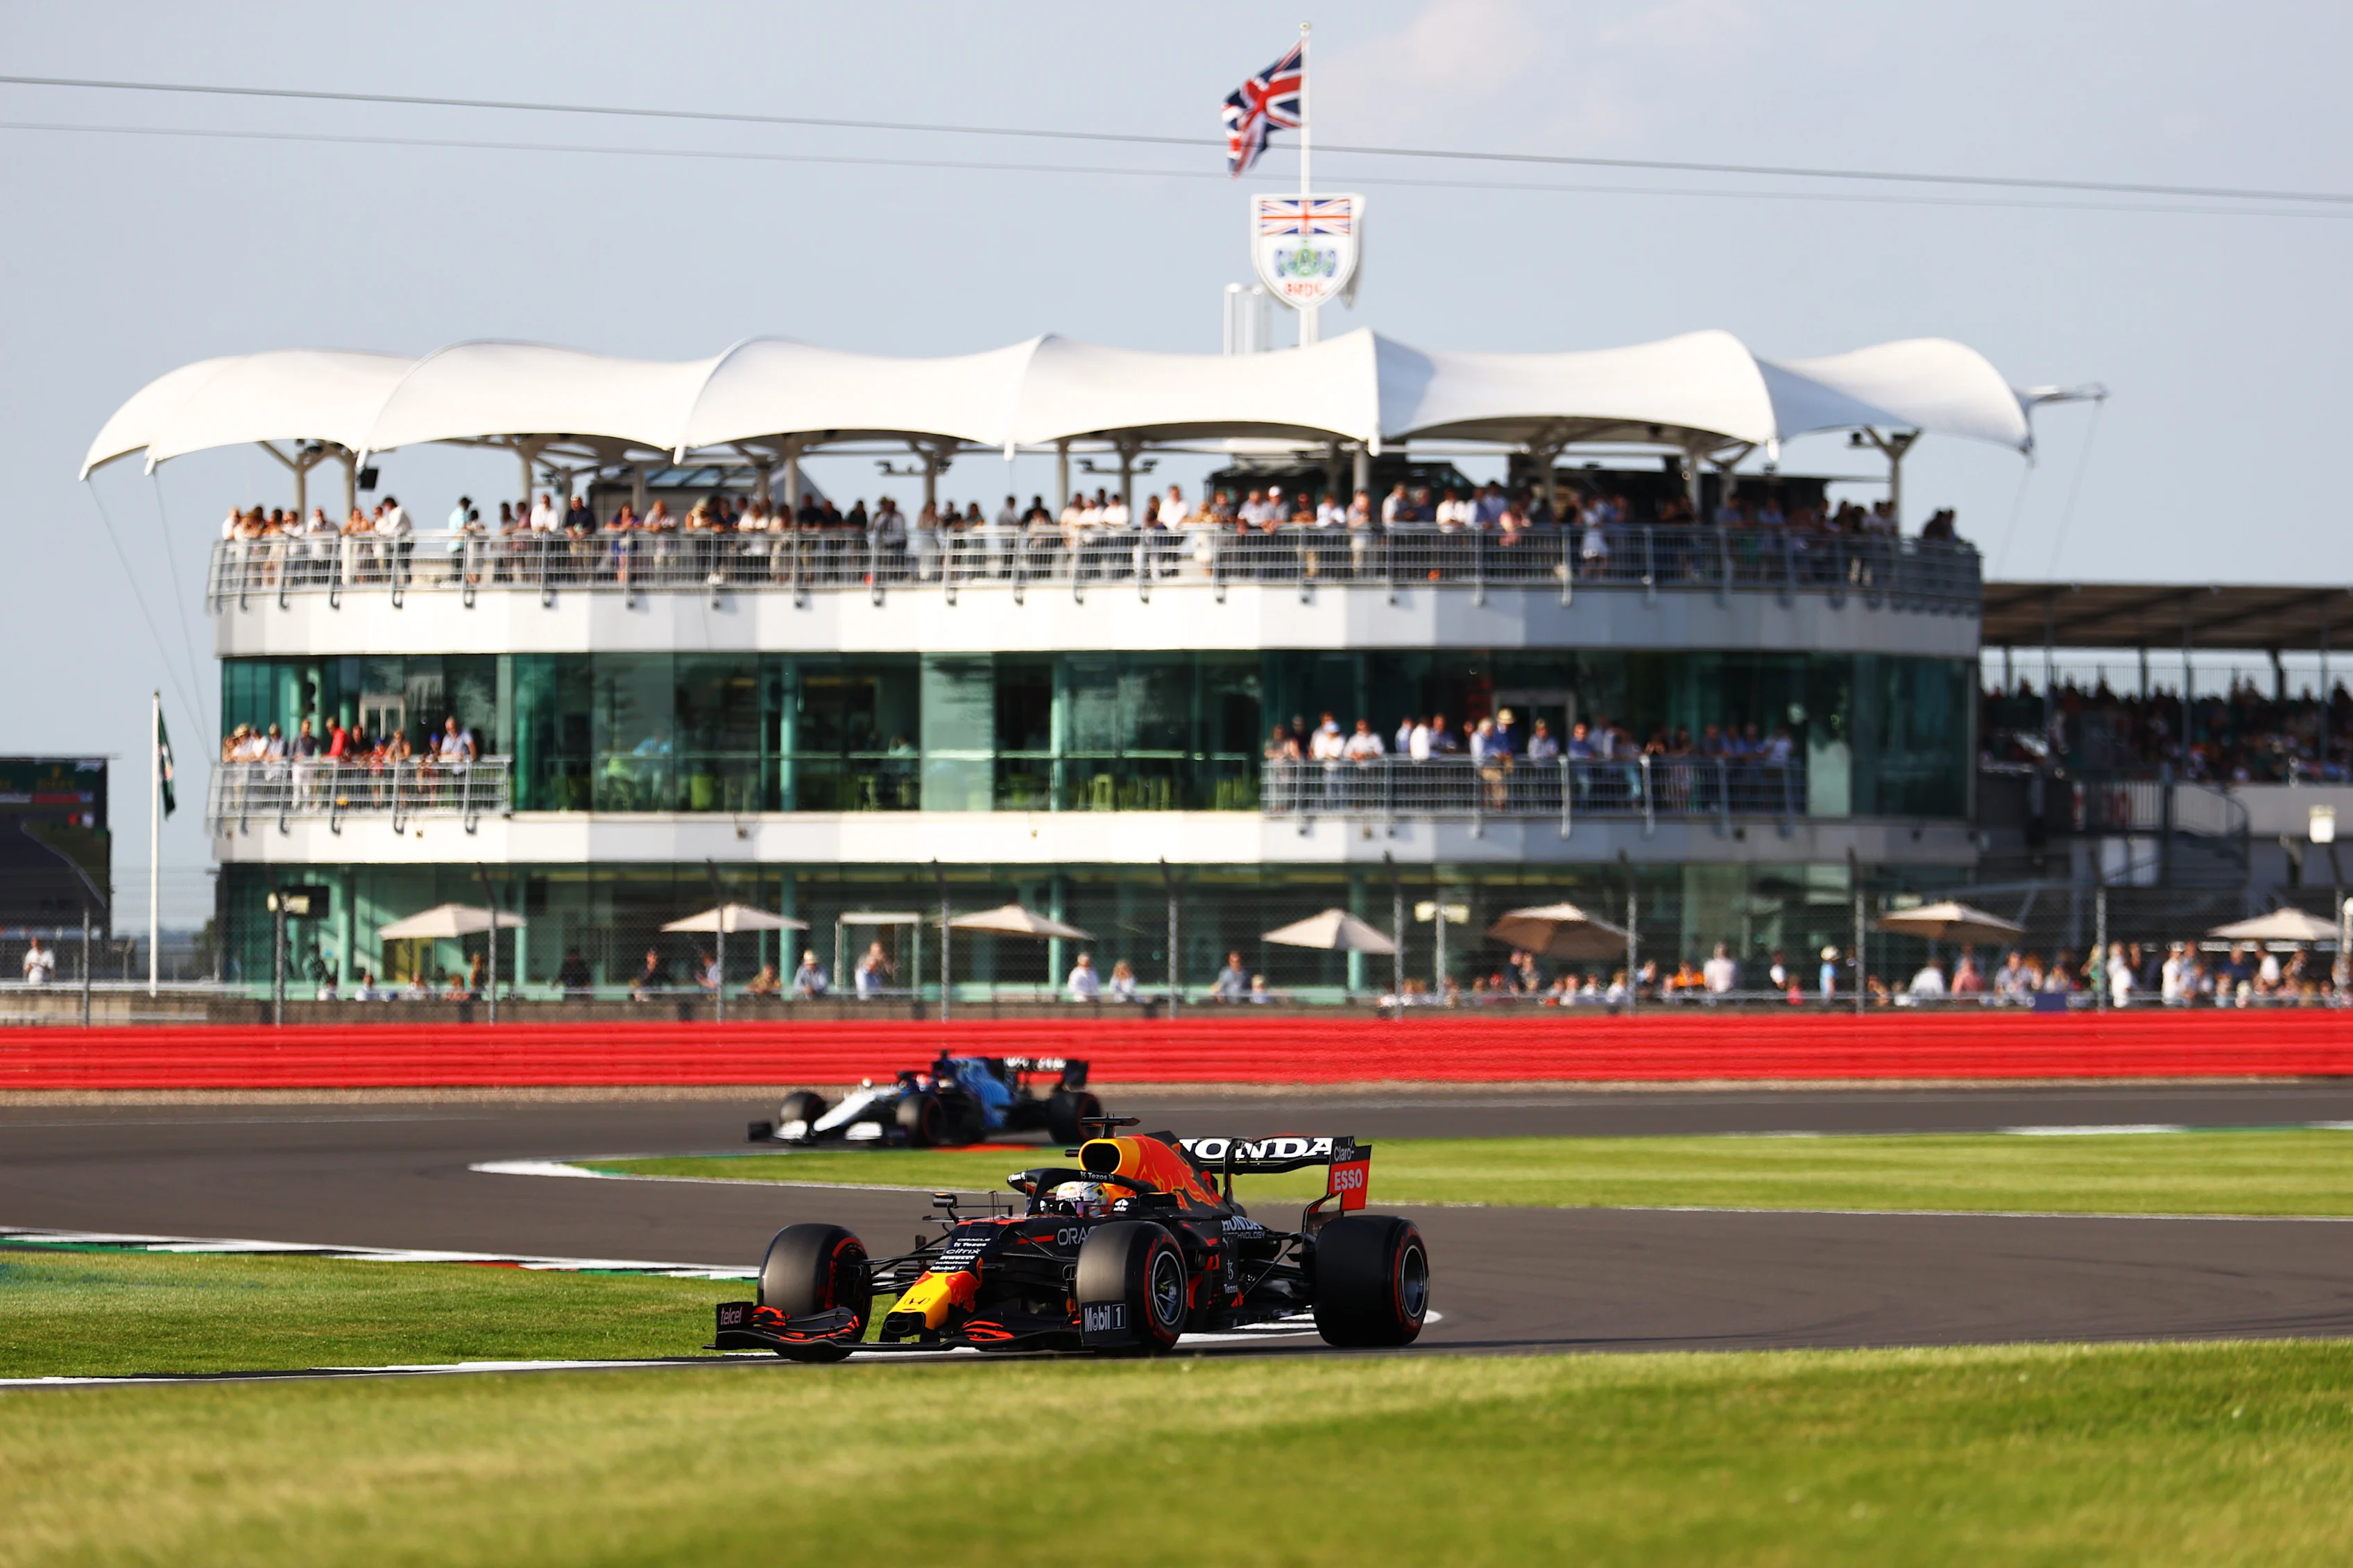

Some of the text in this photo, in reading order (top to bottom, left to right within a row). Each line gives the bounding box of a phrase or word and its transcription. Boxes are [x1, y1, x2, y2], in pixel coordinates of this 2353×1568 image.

[1334, 1146, 1352, 1162] Claro
[1087, 1172, 1108, 1180] Tezos
[1334, 1169, 1363, 1191] ESSO
[720, 1307, 742, 1326] telcel
[1084, 1305, 1110, 1332] Mobil
